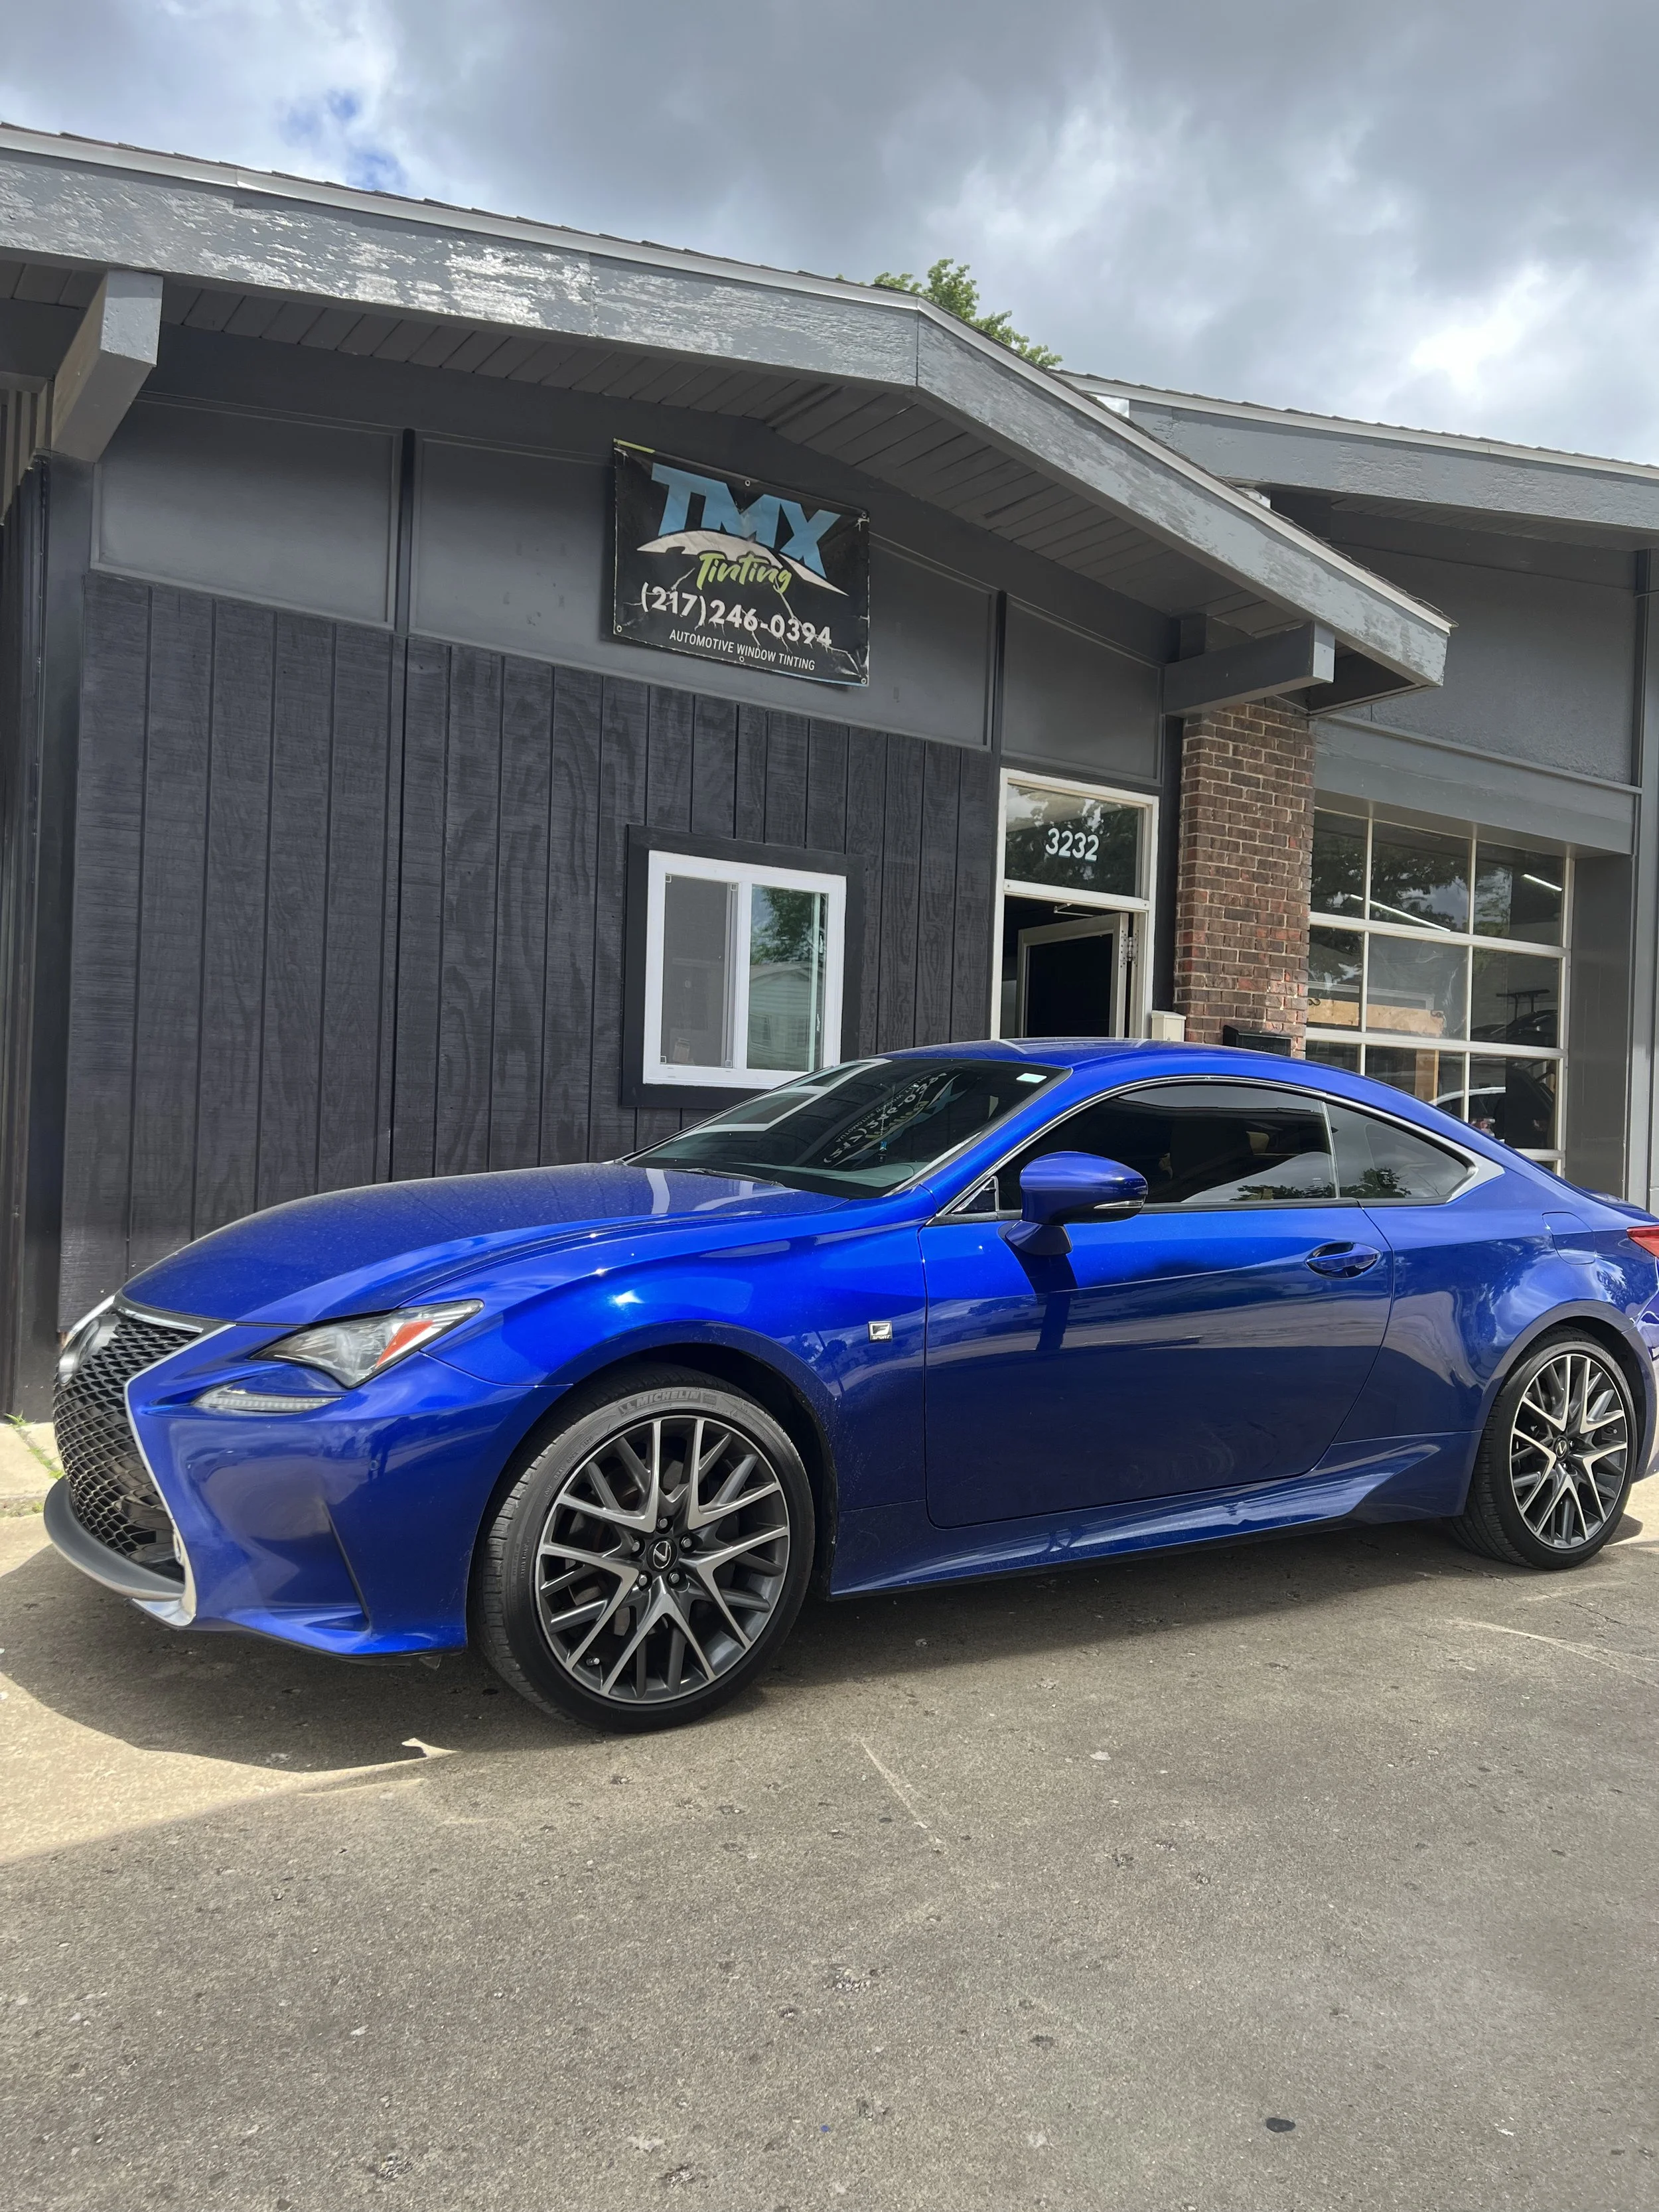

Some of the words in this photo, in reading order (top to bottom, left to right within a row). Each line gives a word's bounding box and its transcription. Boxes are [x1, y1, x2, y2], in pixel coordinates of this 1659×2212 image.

[651, 463, 841, 579] TMX
[696, 553, 792, 593] Tinting
[669, 629, 735, 654] AUTOMOTIVE
[737, 644, 776, 662] WINDOW
[778, 653, 816, 671] TINTING
[1045, 828, 1099, 861] 3232
[636, 1391, 701, 1408] MICHELIN
